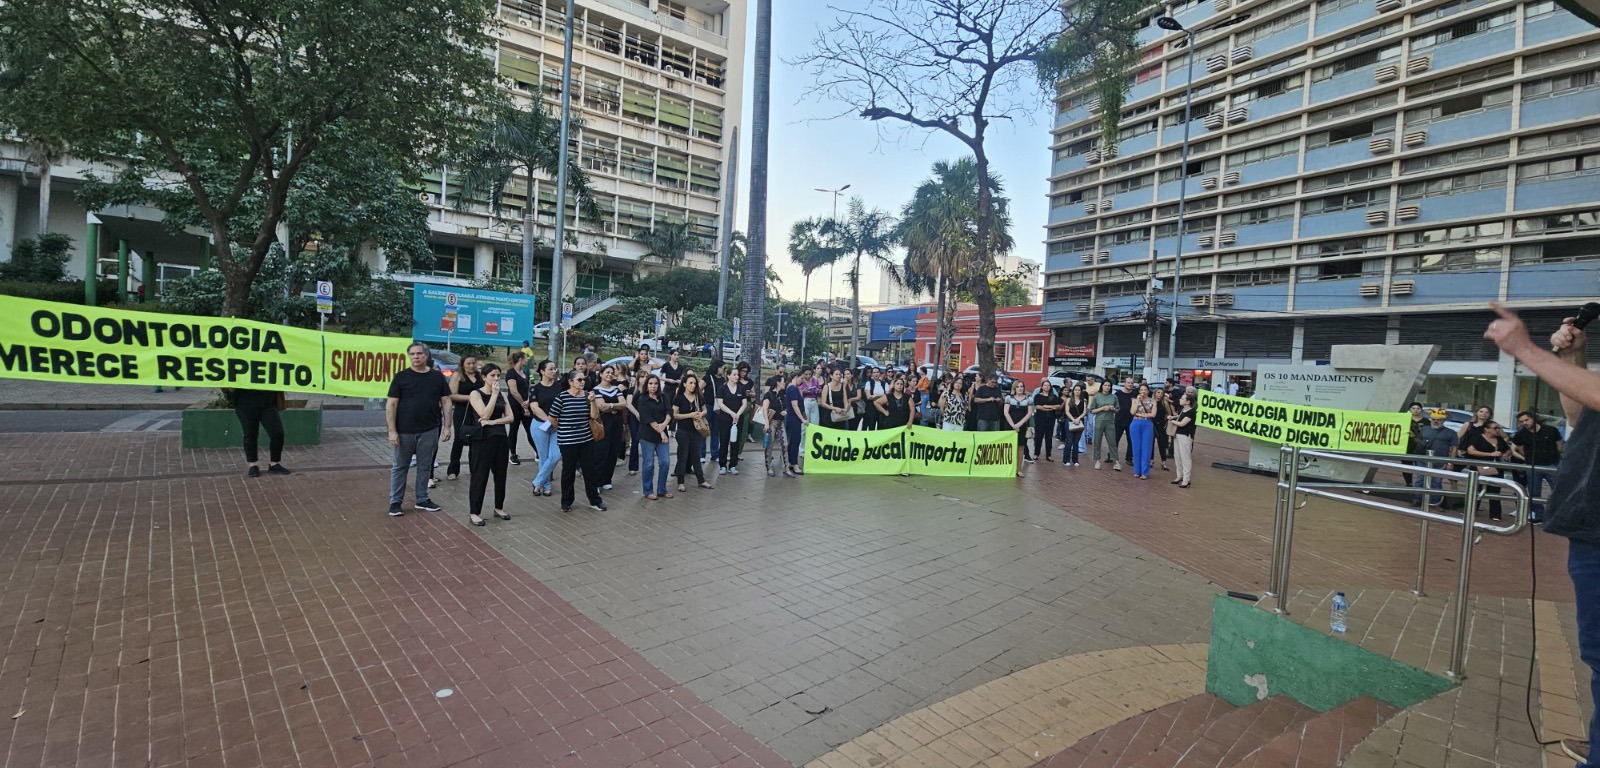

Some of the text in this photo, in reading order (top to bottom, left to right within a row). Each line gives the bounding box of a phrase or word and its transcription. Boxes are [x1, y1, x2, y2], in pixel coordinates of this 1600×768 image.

[31, 309, 287, 354] ODONTOLOGIA
[0, 342, 317, 388] MERECE RESPEITO.
[330, 349, 407, 383] SINODONTO
[1290, 374, 1374, 383] MANDAMENTOS
[1201, 395, 1336, 429] ODONTOLOGIA UNIDA
[1201, 411, 1333, 448] POR SALÁRIO DIGNO.
[1344, 421, 1402, 446] SINODONTO
[811, 431, 968, 467] Saúde bucal importa.
[974, 442, 1013, 466] SINODONTO
